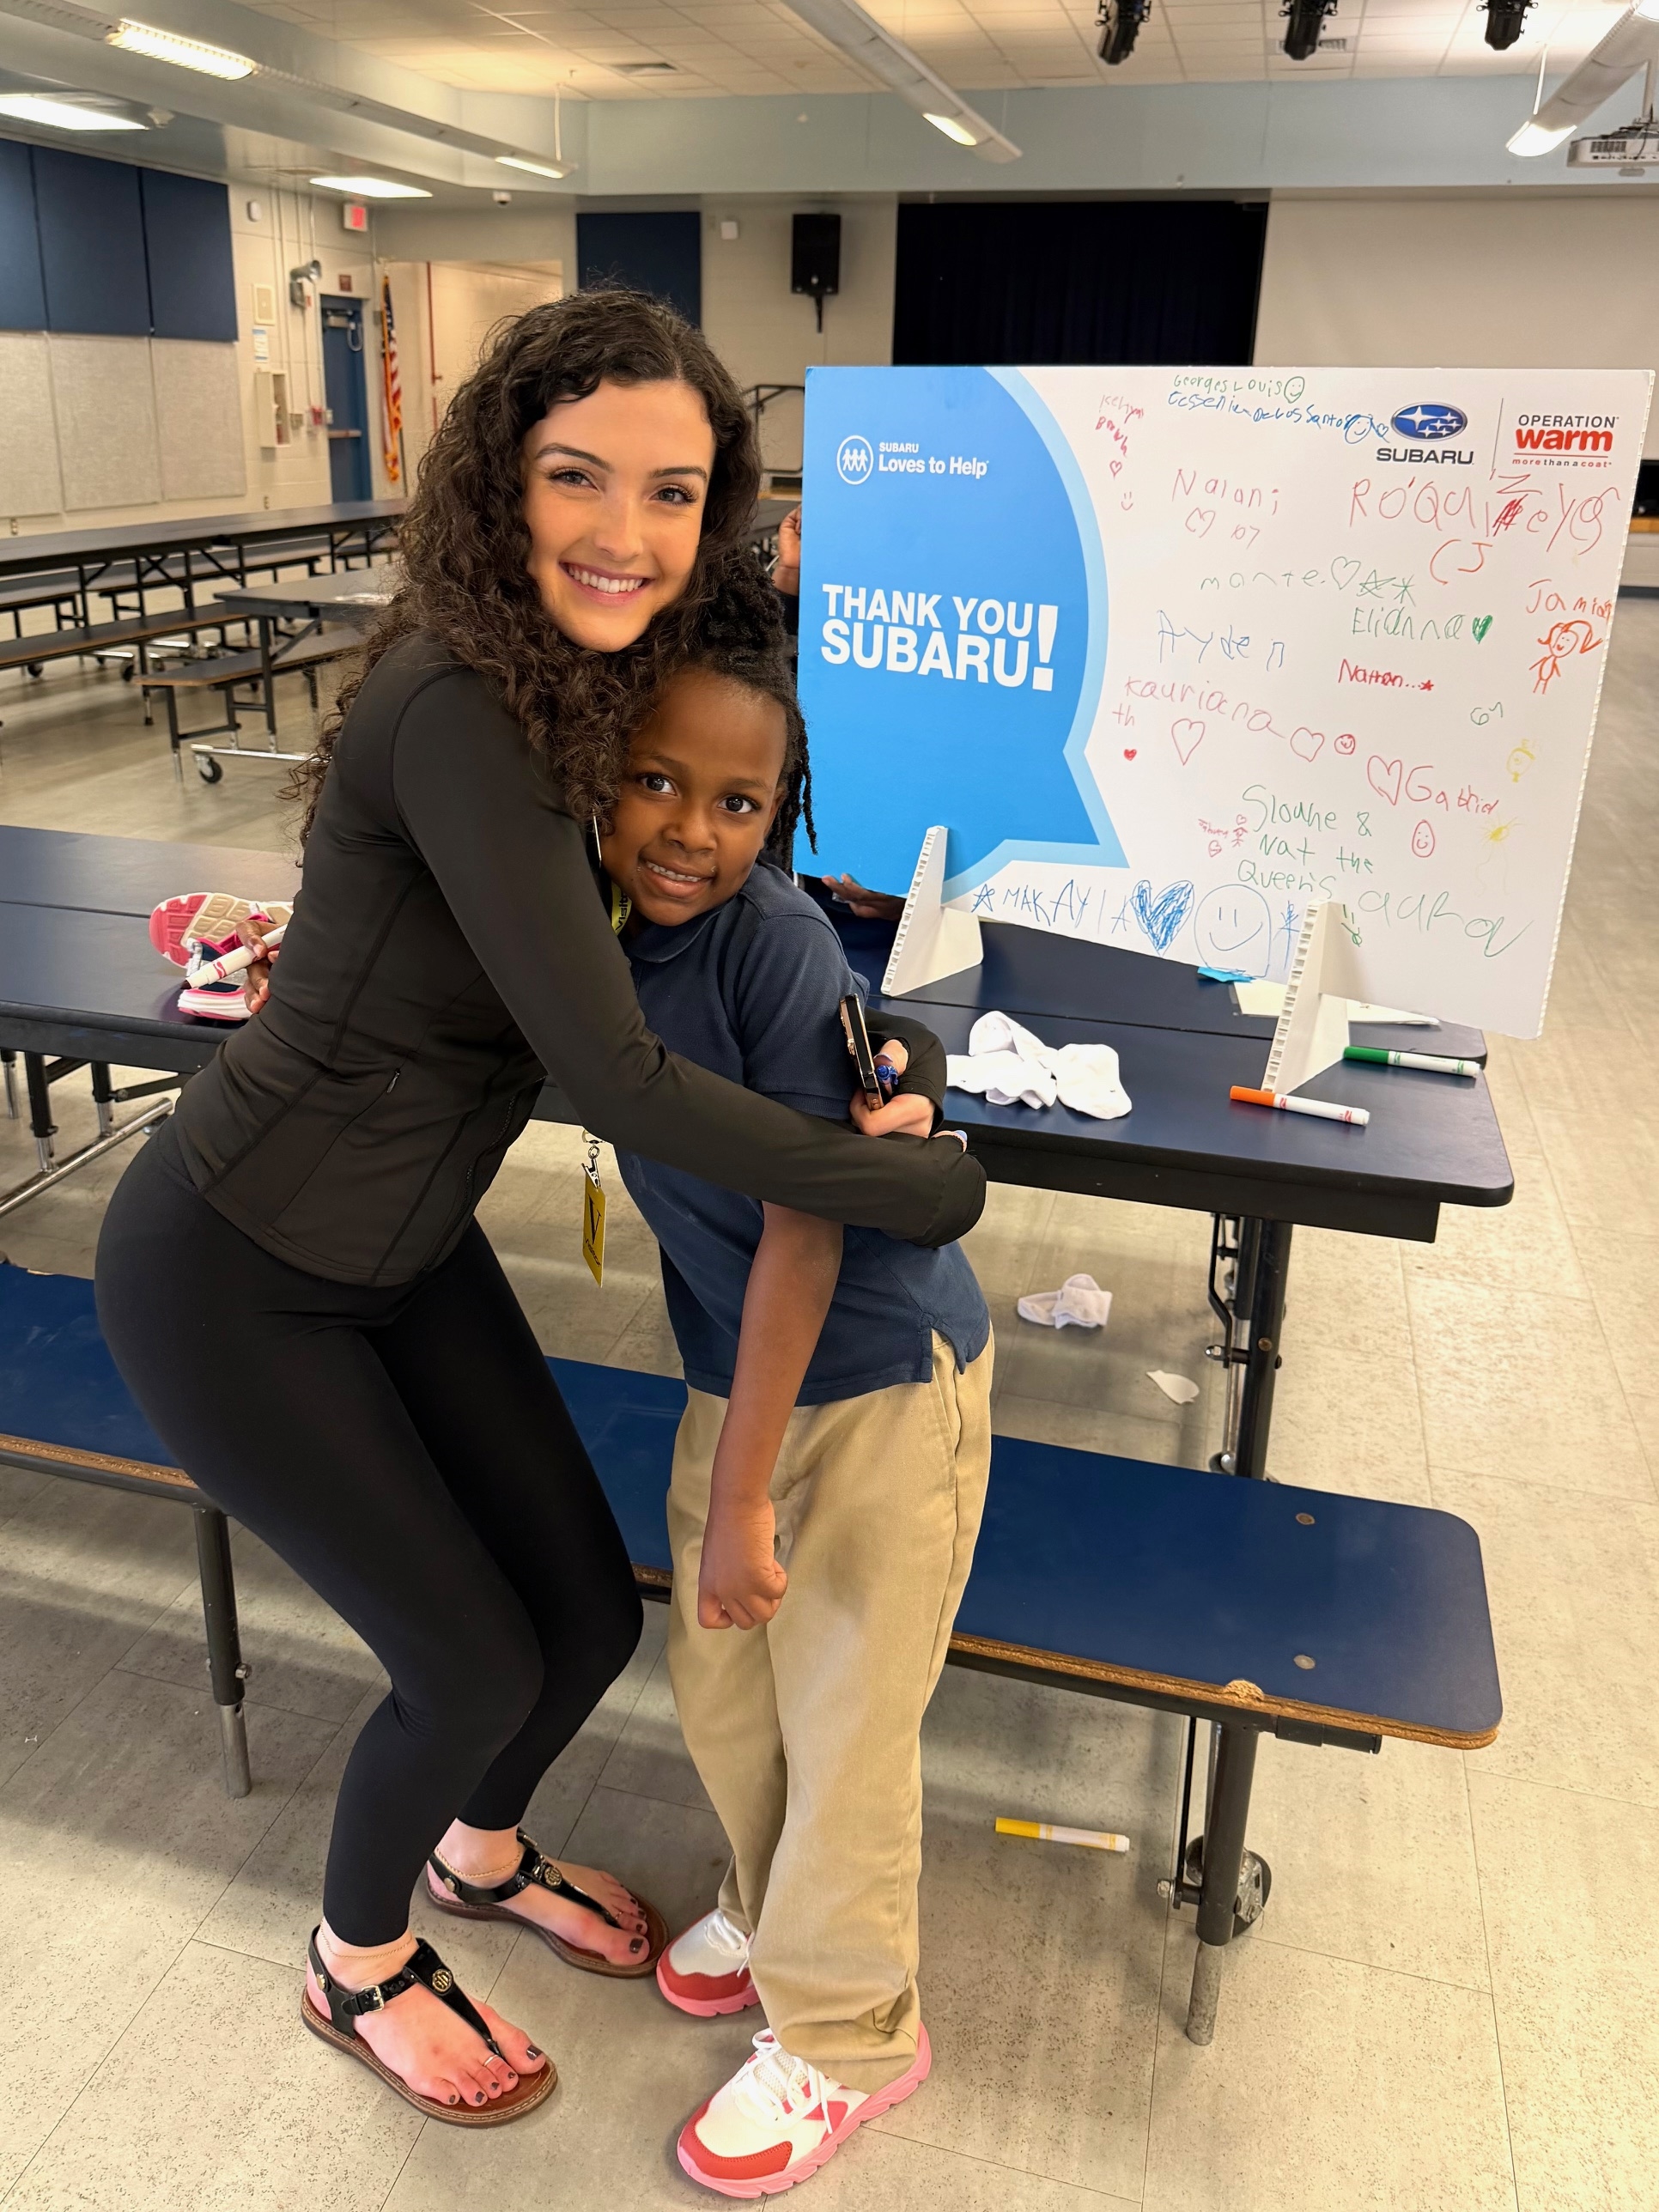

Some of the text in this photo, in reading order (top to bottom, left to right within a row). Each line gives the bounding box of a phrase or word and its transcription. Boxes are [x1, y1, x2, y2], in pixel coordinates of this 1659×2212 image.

[1518, 415, 1616, 428] OPERATION
[878, 441, 919, 453] SUBARU
[1516, 428, 1613, 452] warm
[878, 453, 988, 479] Loves to Help
[1376, 448, 1474, 465] SUBARU
[822, 583, 1034, 638] THANK YOU
[821, 605, 1058, 691] SUBARU!
